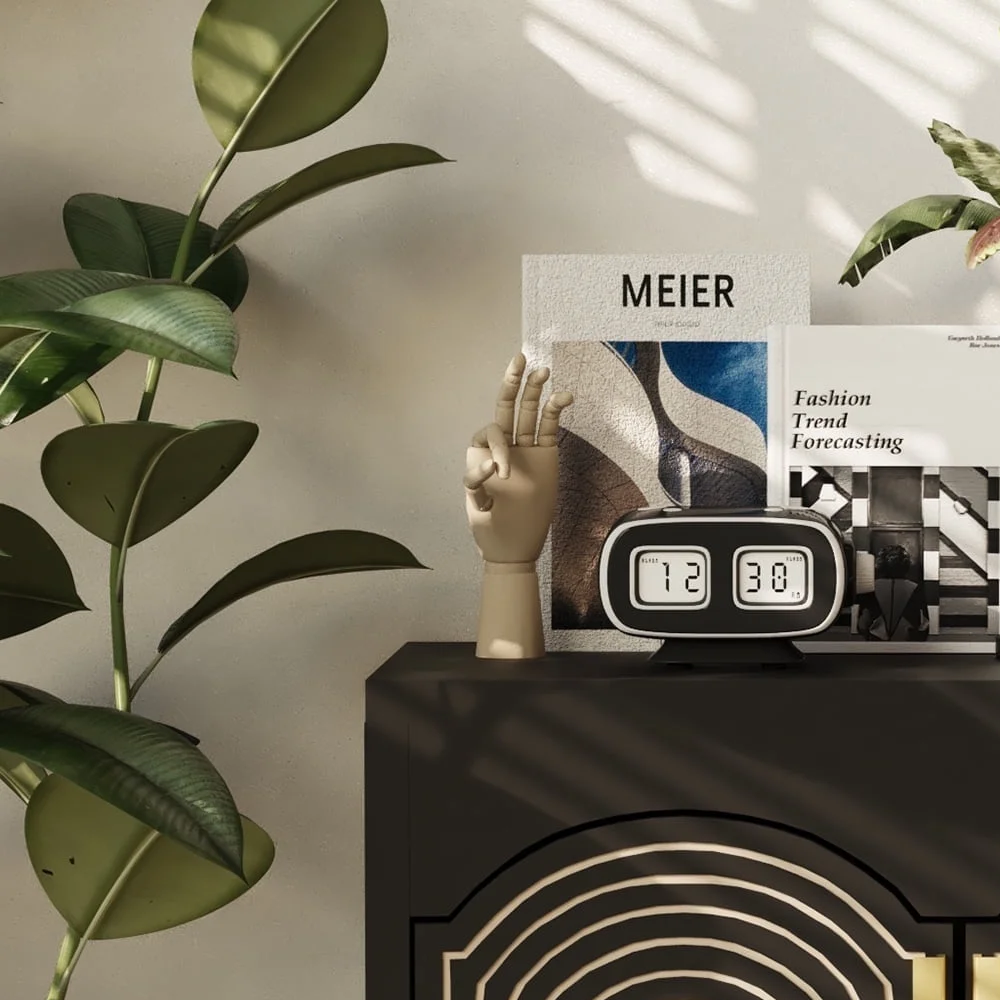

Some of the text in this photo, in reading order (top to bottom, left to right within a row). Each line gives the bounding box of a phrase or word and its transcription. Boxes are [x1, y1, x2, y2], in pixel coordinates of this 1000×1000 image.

[622, 274, 734, 307] MEIER
[793, 389, 872, 406] Fashion
[791, 412, 848, 429] Trend
[790, 432, 904, 455] Forecasting
[662, 562, 787, 592] 12 30
